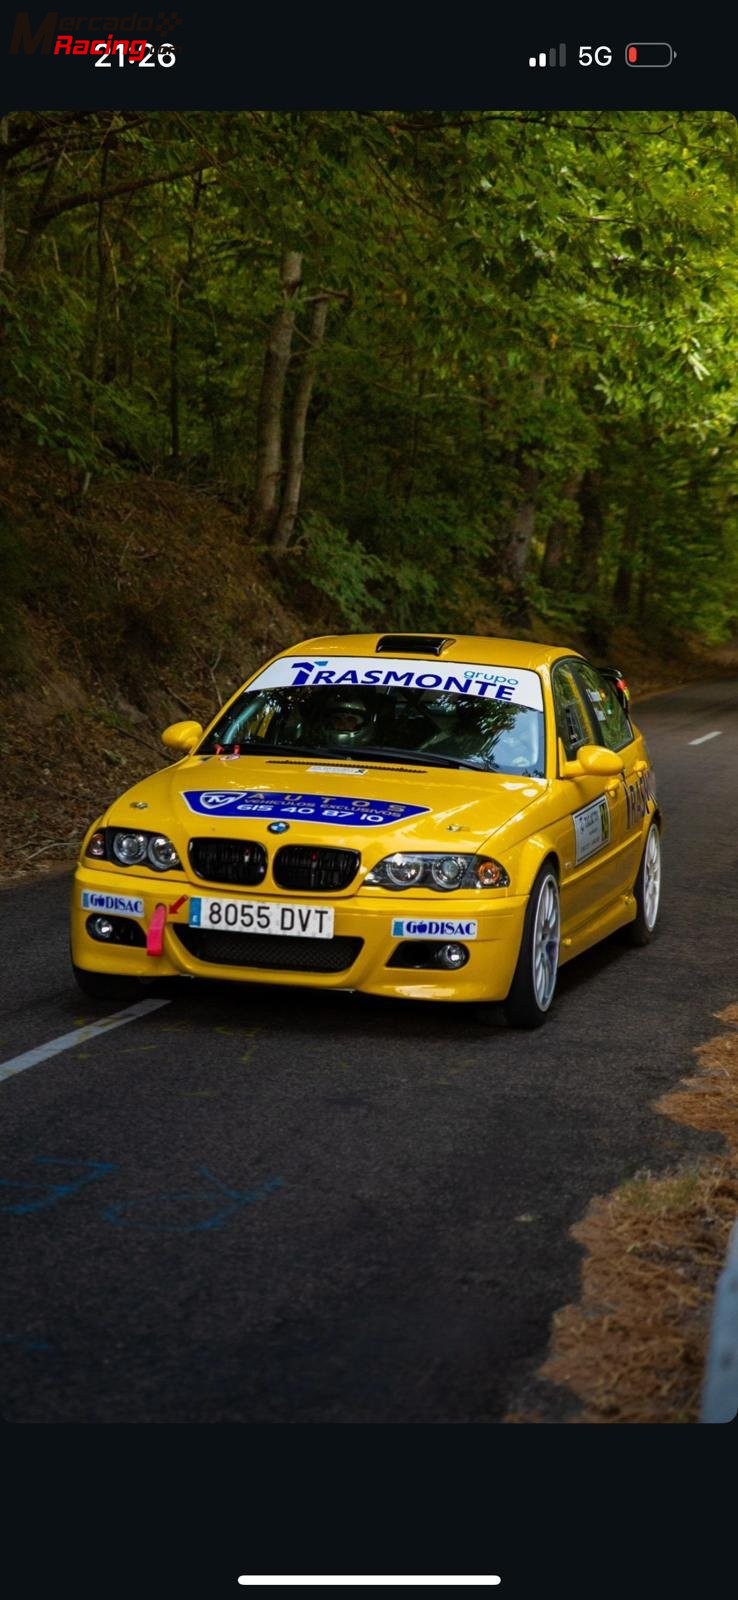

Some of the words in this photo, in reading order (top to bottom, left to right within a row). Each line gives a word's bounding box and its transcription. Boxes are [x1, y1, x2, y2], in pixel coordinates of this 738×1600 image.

[291, 661, 516, 701] TRASMONTE
[463, 670, 519, 686] grupo
[244, 798, 316, 807] VEHICULOS
[320, 803, 402, 818] EXCLUSIVOS
[280, 806, 315, 814] 40
[322, 809, 355, 818] 87
[360, 813, 384, 822] 10
[208, 902, 270, 929] 8055
[281, 907, 329, 934] DVT
